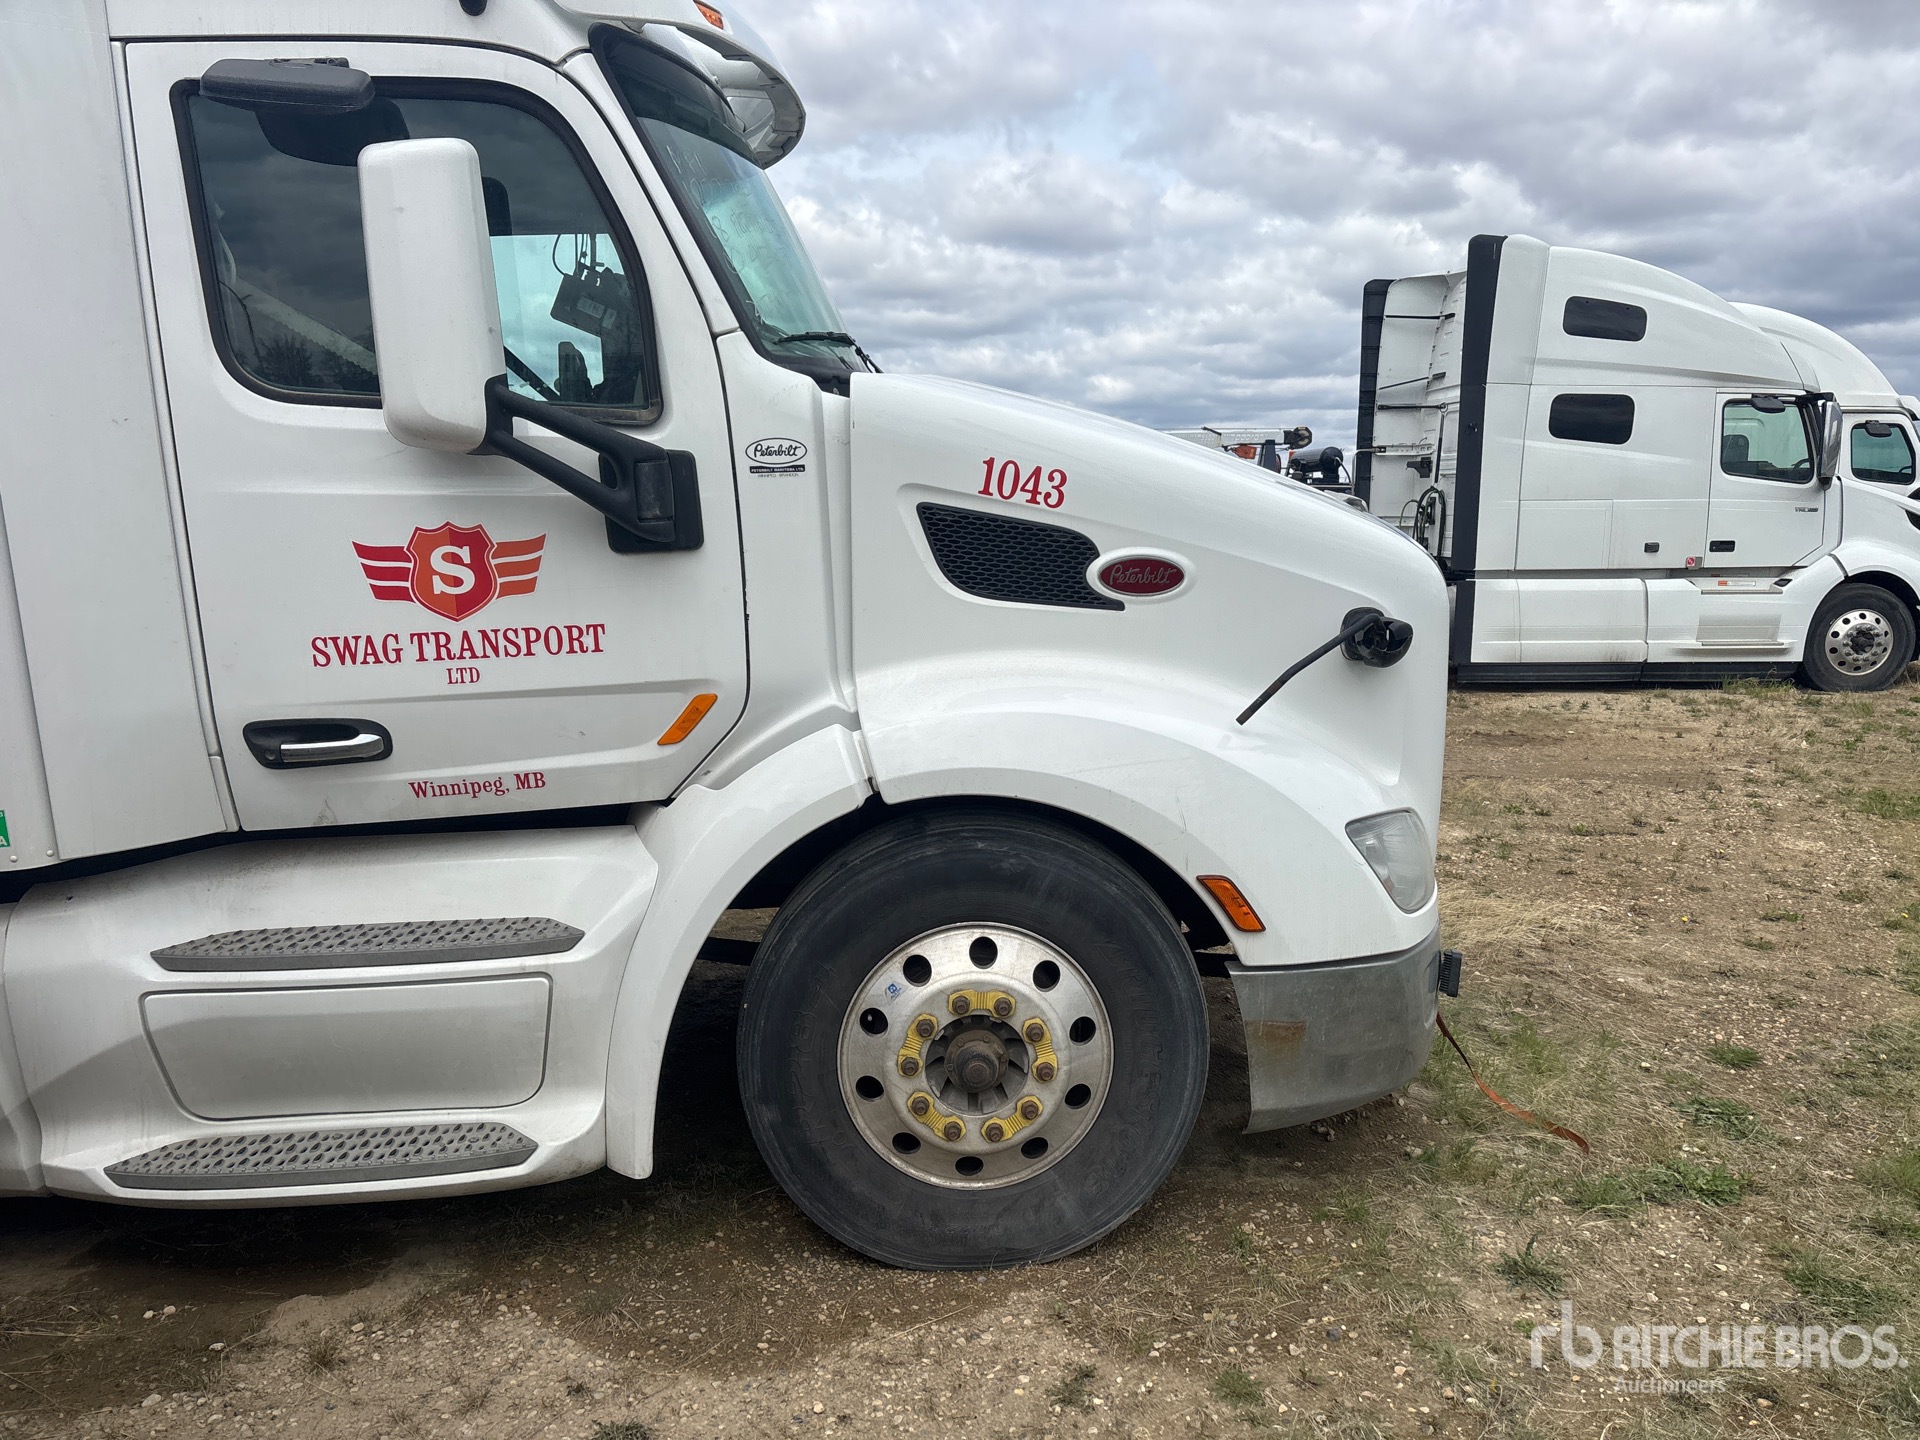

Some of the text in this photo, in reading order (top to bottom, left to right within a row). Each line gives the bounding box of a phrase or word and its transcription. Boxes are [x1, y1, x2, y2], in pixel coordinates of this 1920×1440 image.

[753, 443, 801, 458] Peterbilt
[977, 456, 1068, 509] 1043
[429, 545, 476, 595] S
[1109, 564, 1177, 586] Peterbilt
[310, 623, 606, 668] SWAG TRANSPORT
[445, 667, 480, 685] LTD
[408, 771, 547, 799] Winnipeg, MB
